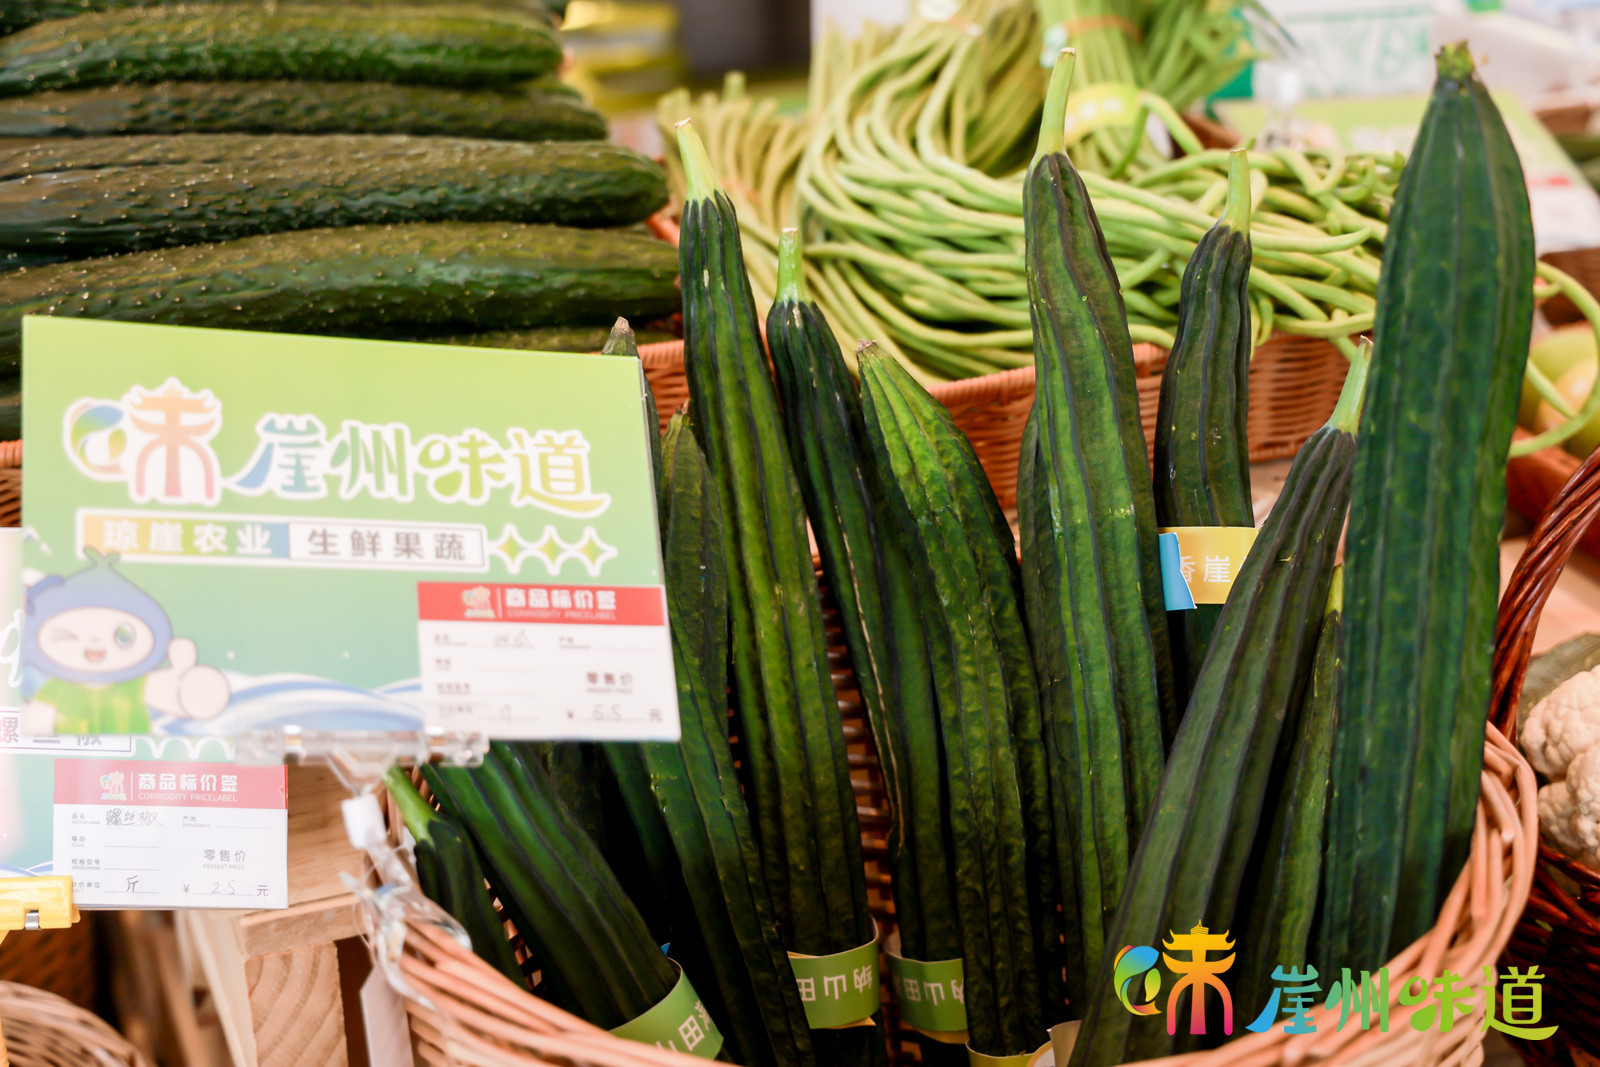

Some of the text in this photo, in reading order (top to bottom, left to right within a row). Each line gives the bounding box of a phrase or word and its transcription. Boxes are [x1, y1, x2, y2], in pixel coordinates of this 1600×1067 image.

[234, 417, 607, 513] 崖州味道
[102, 519, 466, 561] 琼崖农业 生鲜果蔬
[505, 588, 616, 610] 商品标价签
[138, 772, 238, 792] 商品标价签
[138, 791, 187, 801] COMMODITY
[190, 793, 237, 802] PRICELABEL
[203, 848, 246, 862] 零售价
[256, 884, 270, 897] 元
